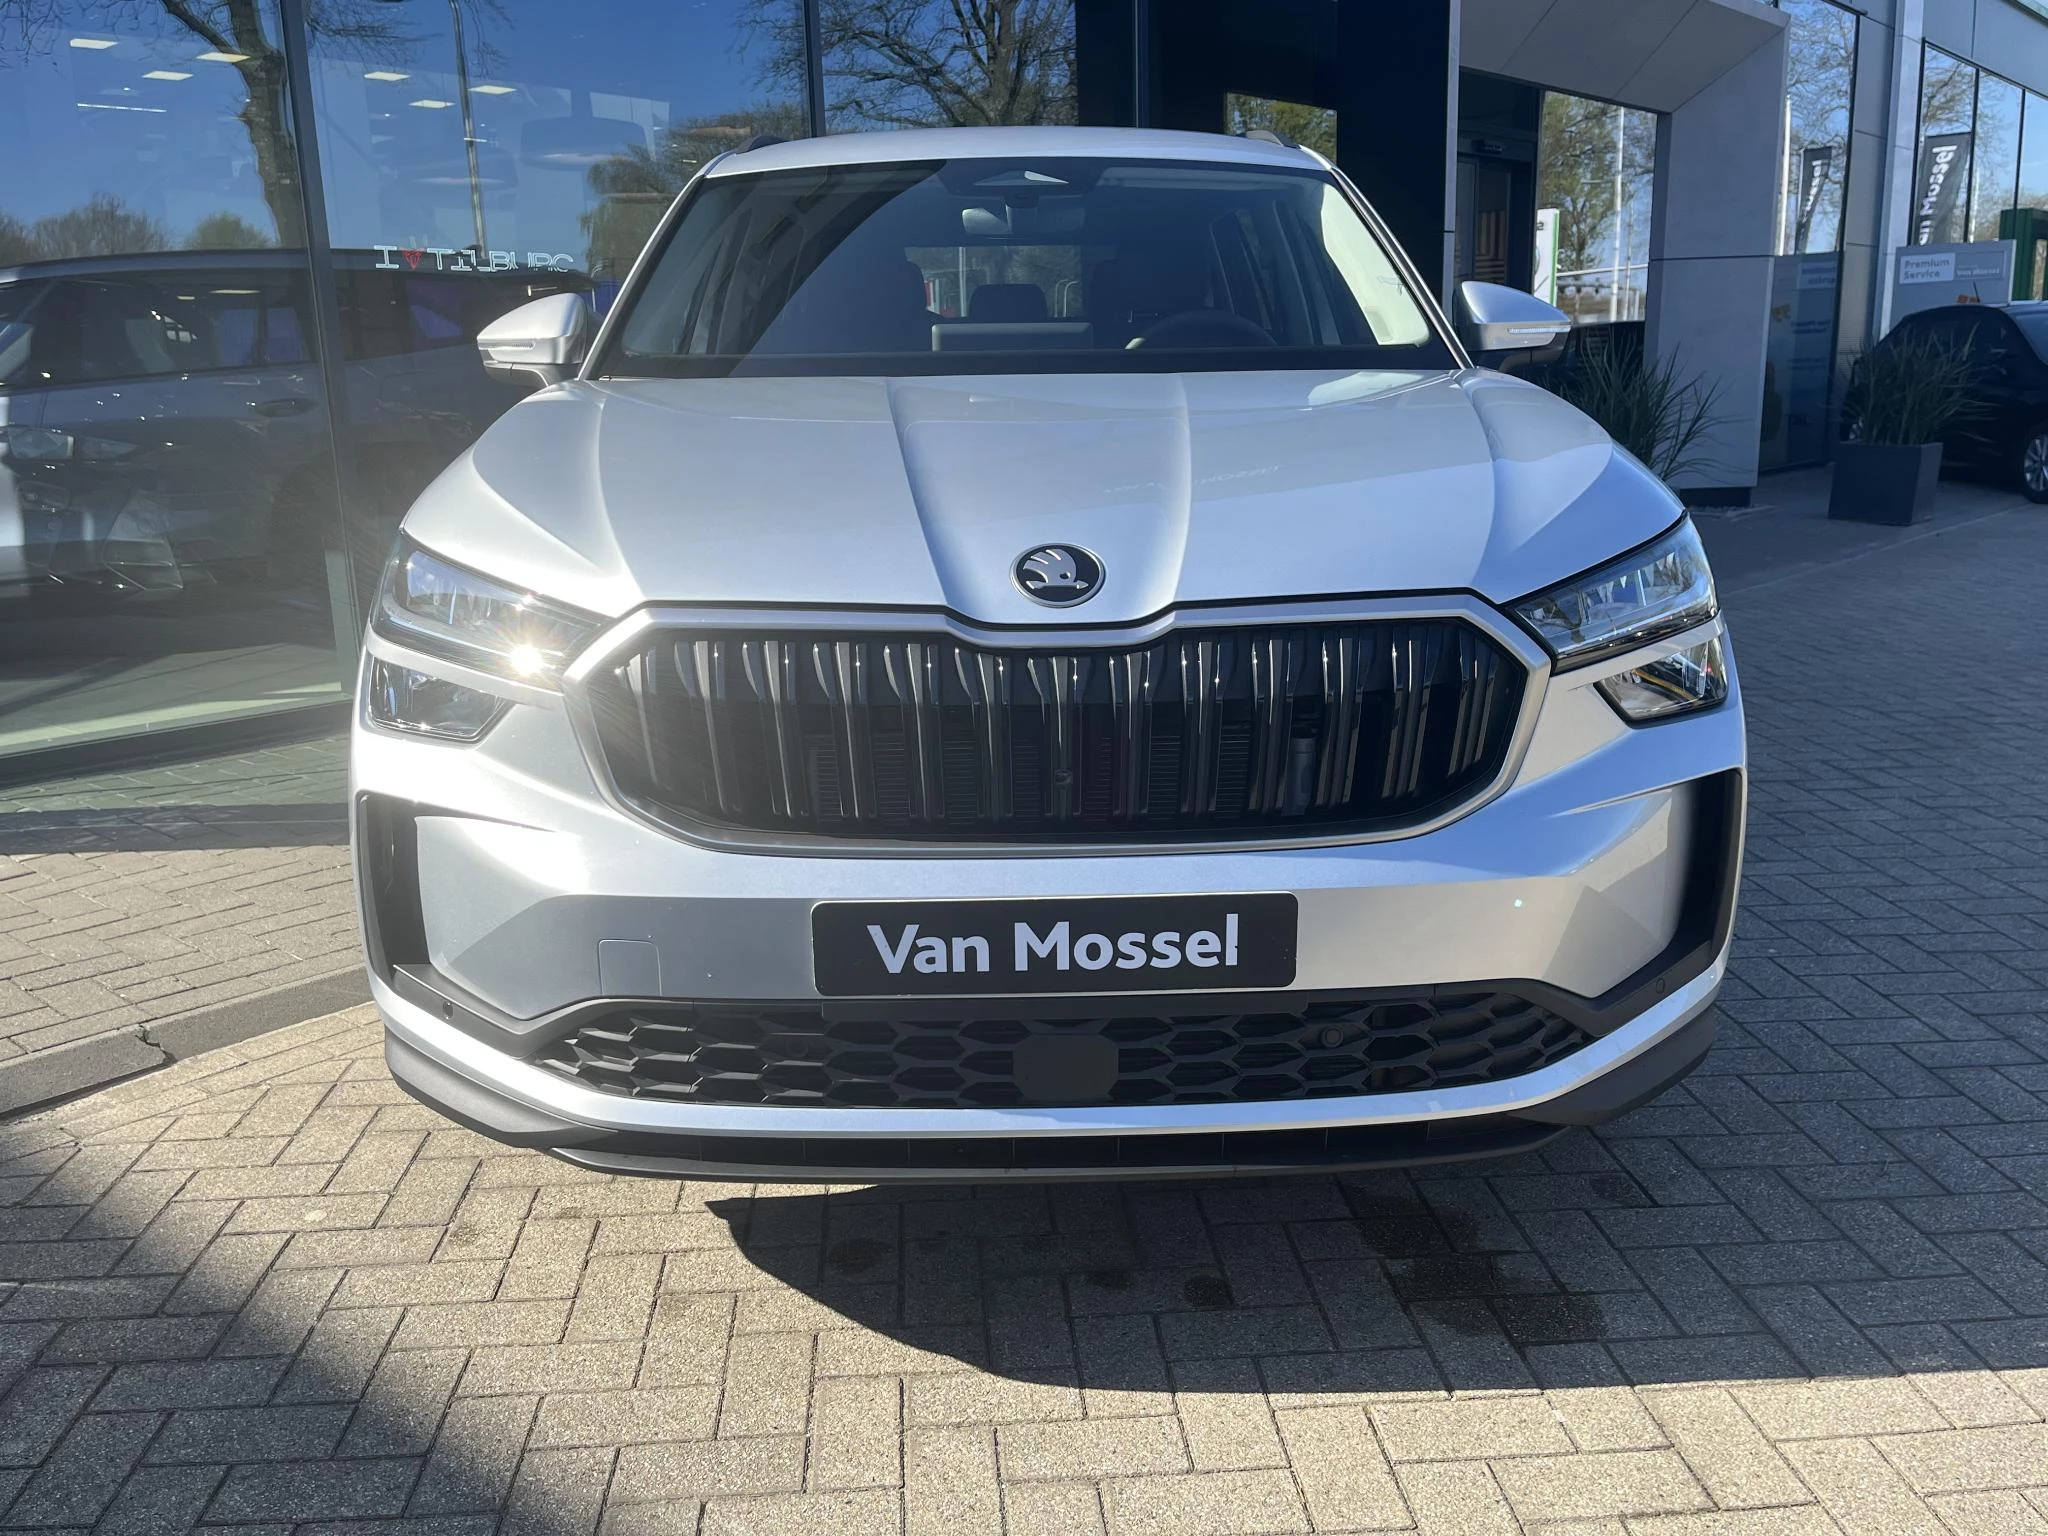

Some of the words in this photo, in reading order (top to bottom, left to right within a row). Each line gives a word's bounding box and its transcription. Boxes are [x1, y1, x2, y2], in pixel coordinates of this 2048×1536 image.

[1919, 145, 1958, 216] Mossel
[1904, 259, 1950, 269] Premium
[1904, 270, 1941, 280] Service
[867, 923, 990, 974] Van
[1014, 913, 1239, 971] Mossel
